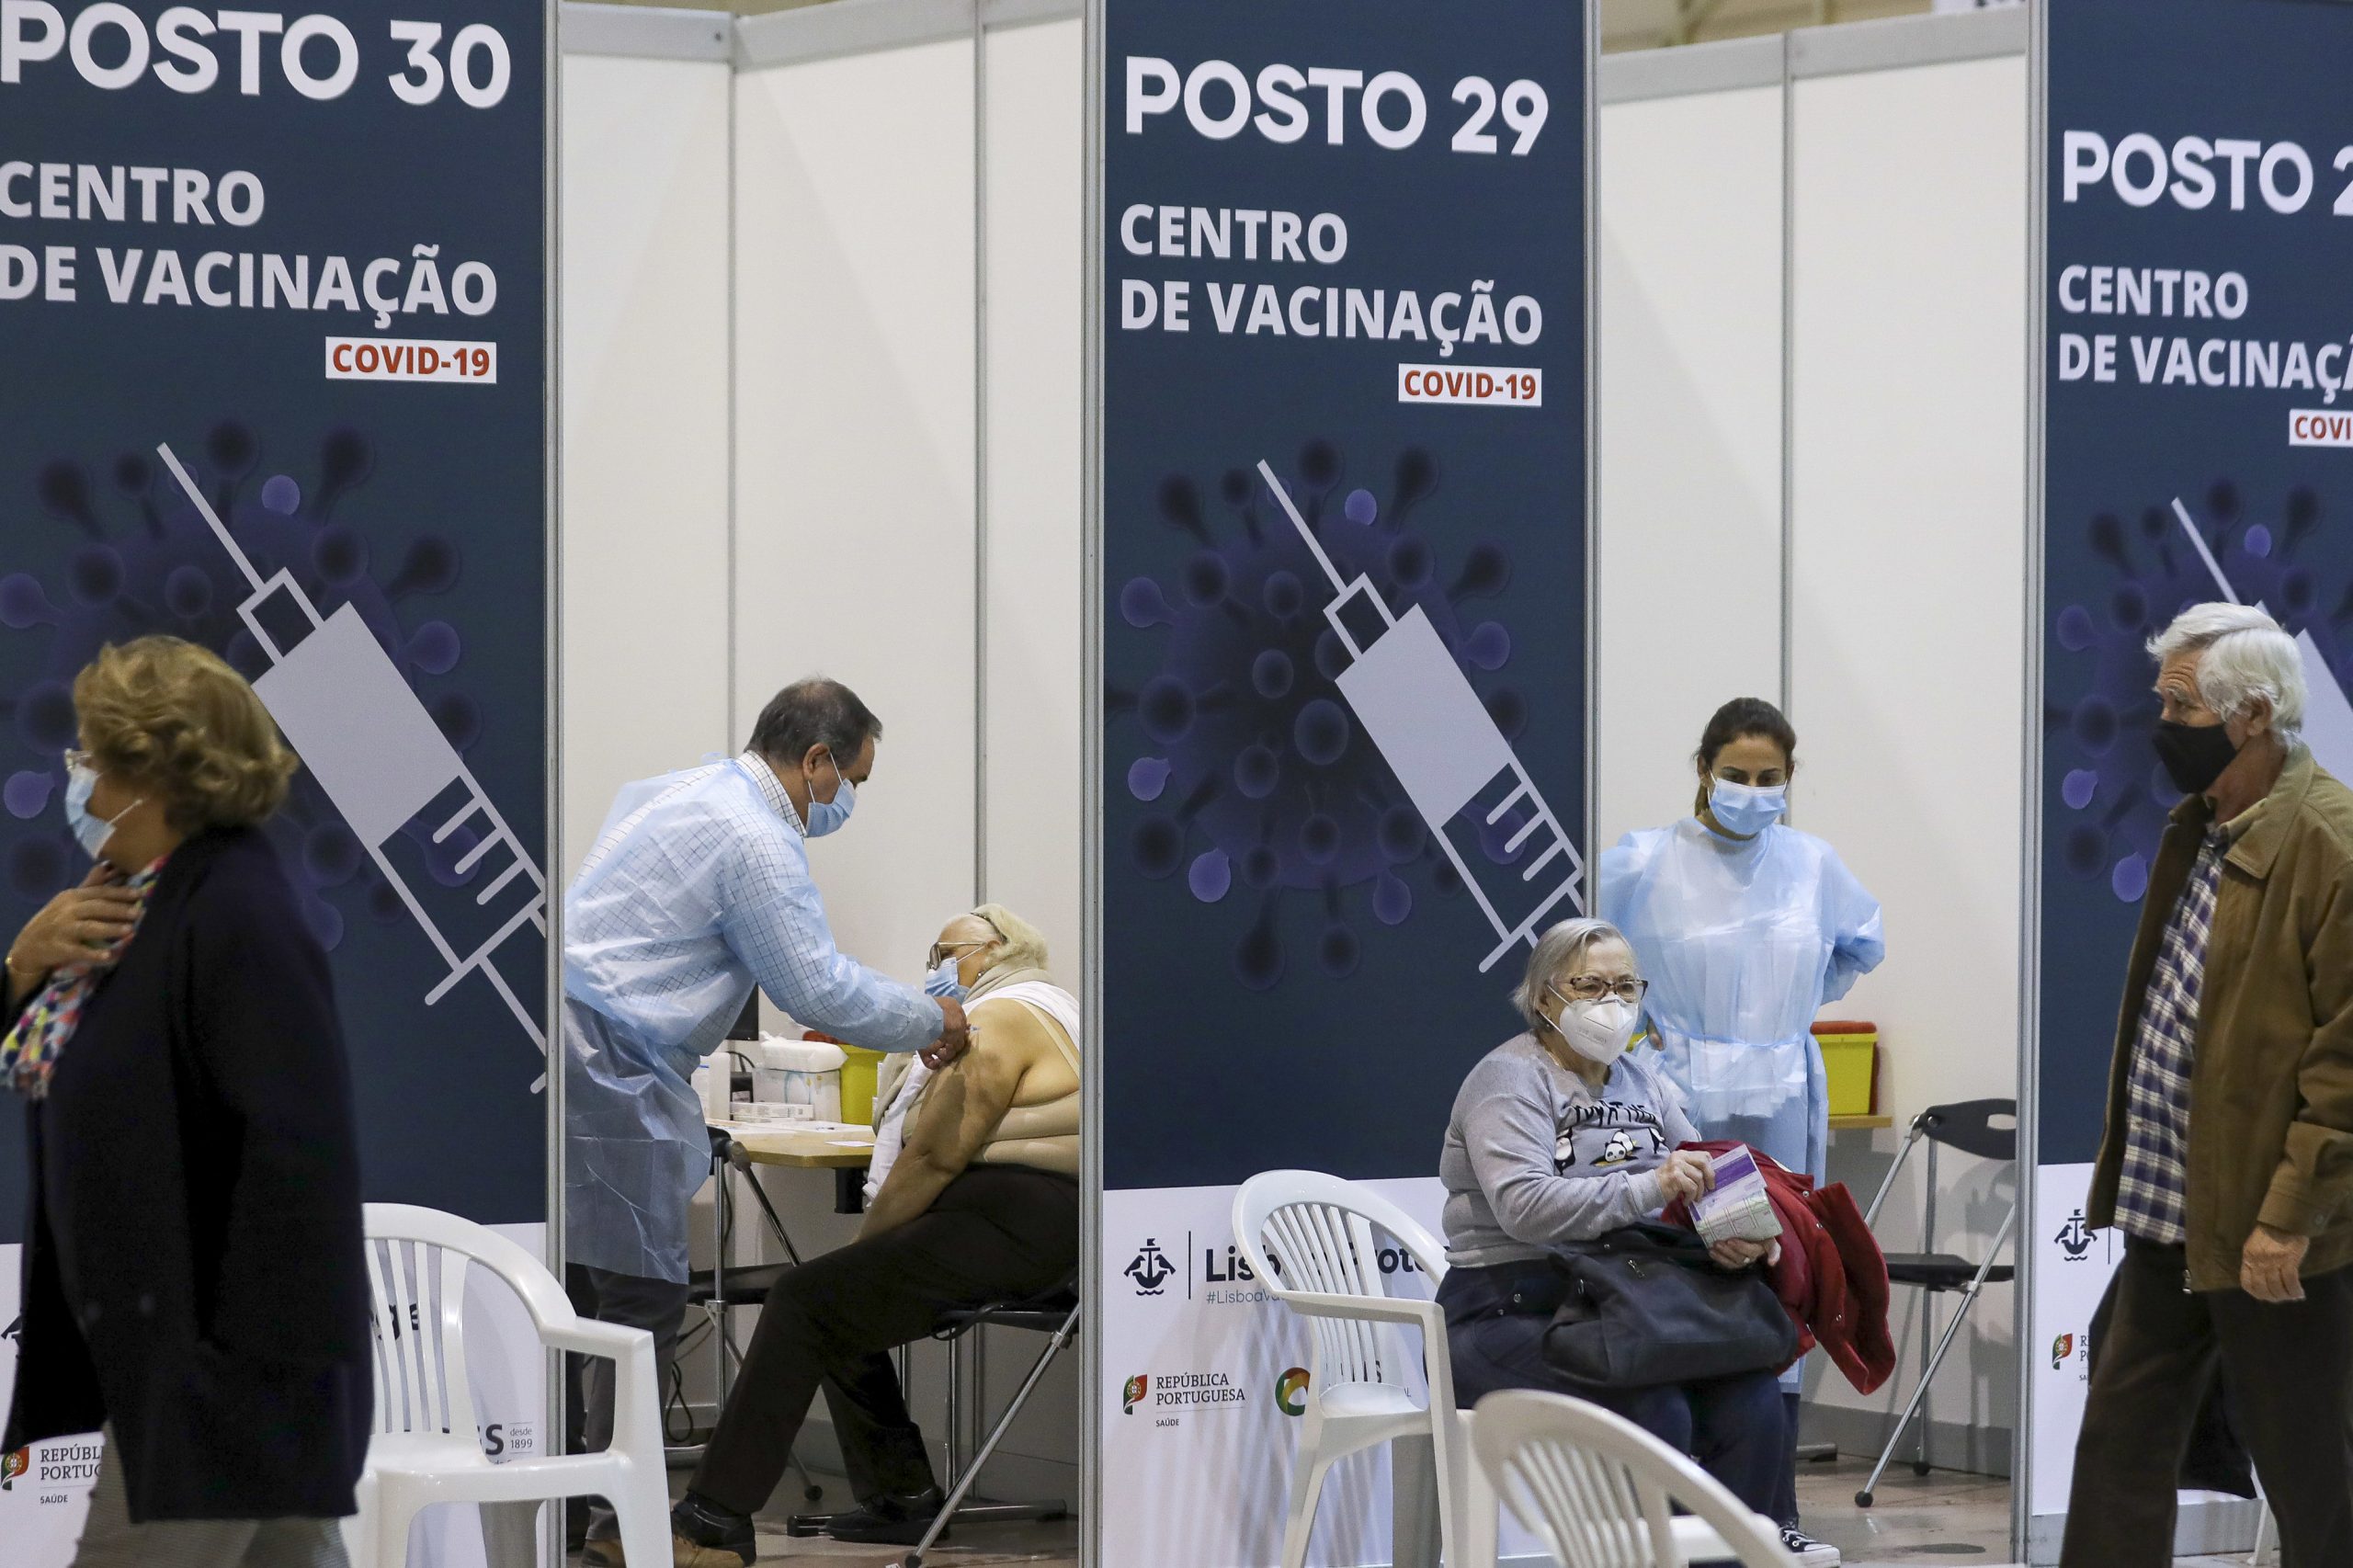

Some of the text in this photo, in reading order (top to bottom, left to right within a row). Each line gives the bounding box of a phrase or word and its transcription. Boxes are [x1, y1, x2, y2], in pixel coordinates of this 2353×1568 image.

[0, 0, 511, 108] POSTO 30
[1126, 55, 1549, 155] POSTO 29
[0, 161, 265, 226] CENTRO
[2063, 130, 2314, 214] POSTO
[1120, 203, 1348, 264] CENTRO
[0, 243, 497, 329] DE VACINAÇÃO
[2058, 264, 2249, 320] CENTRO
[1121, 278, 1542, 358] DE VACINAÇÃO
[333, 343, 491, 377] COVID-19
[2059, 333, 2117, 382] DE
[1404, 369, 1537, 401] COVID-19
[1156, 1372, 1229, 1389] REPÚBLICA
[1156, 1388, 1245, 1405] PORTUGUESA
[510, 1427, 532, 1436] desde
[511, 1438, 533, 1449] 1899
[1156, 1417, 1179, 1426] SAÚDE
[40, 1493, 68, 1504] SAÚDE
